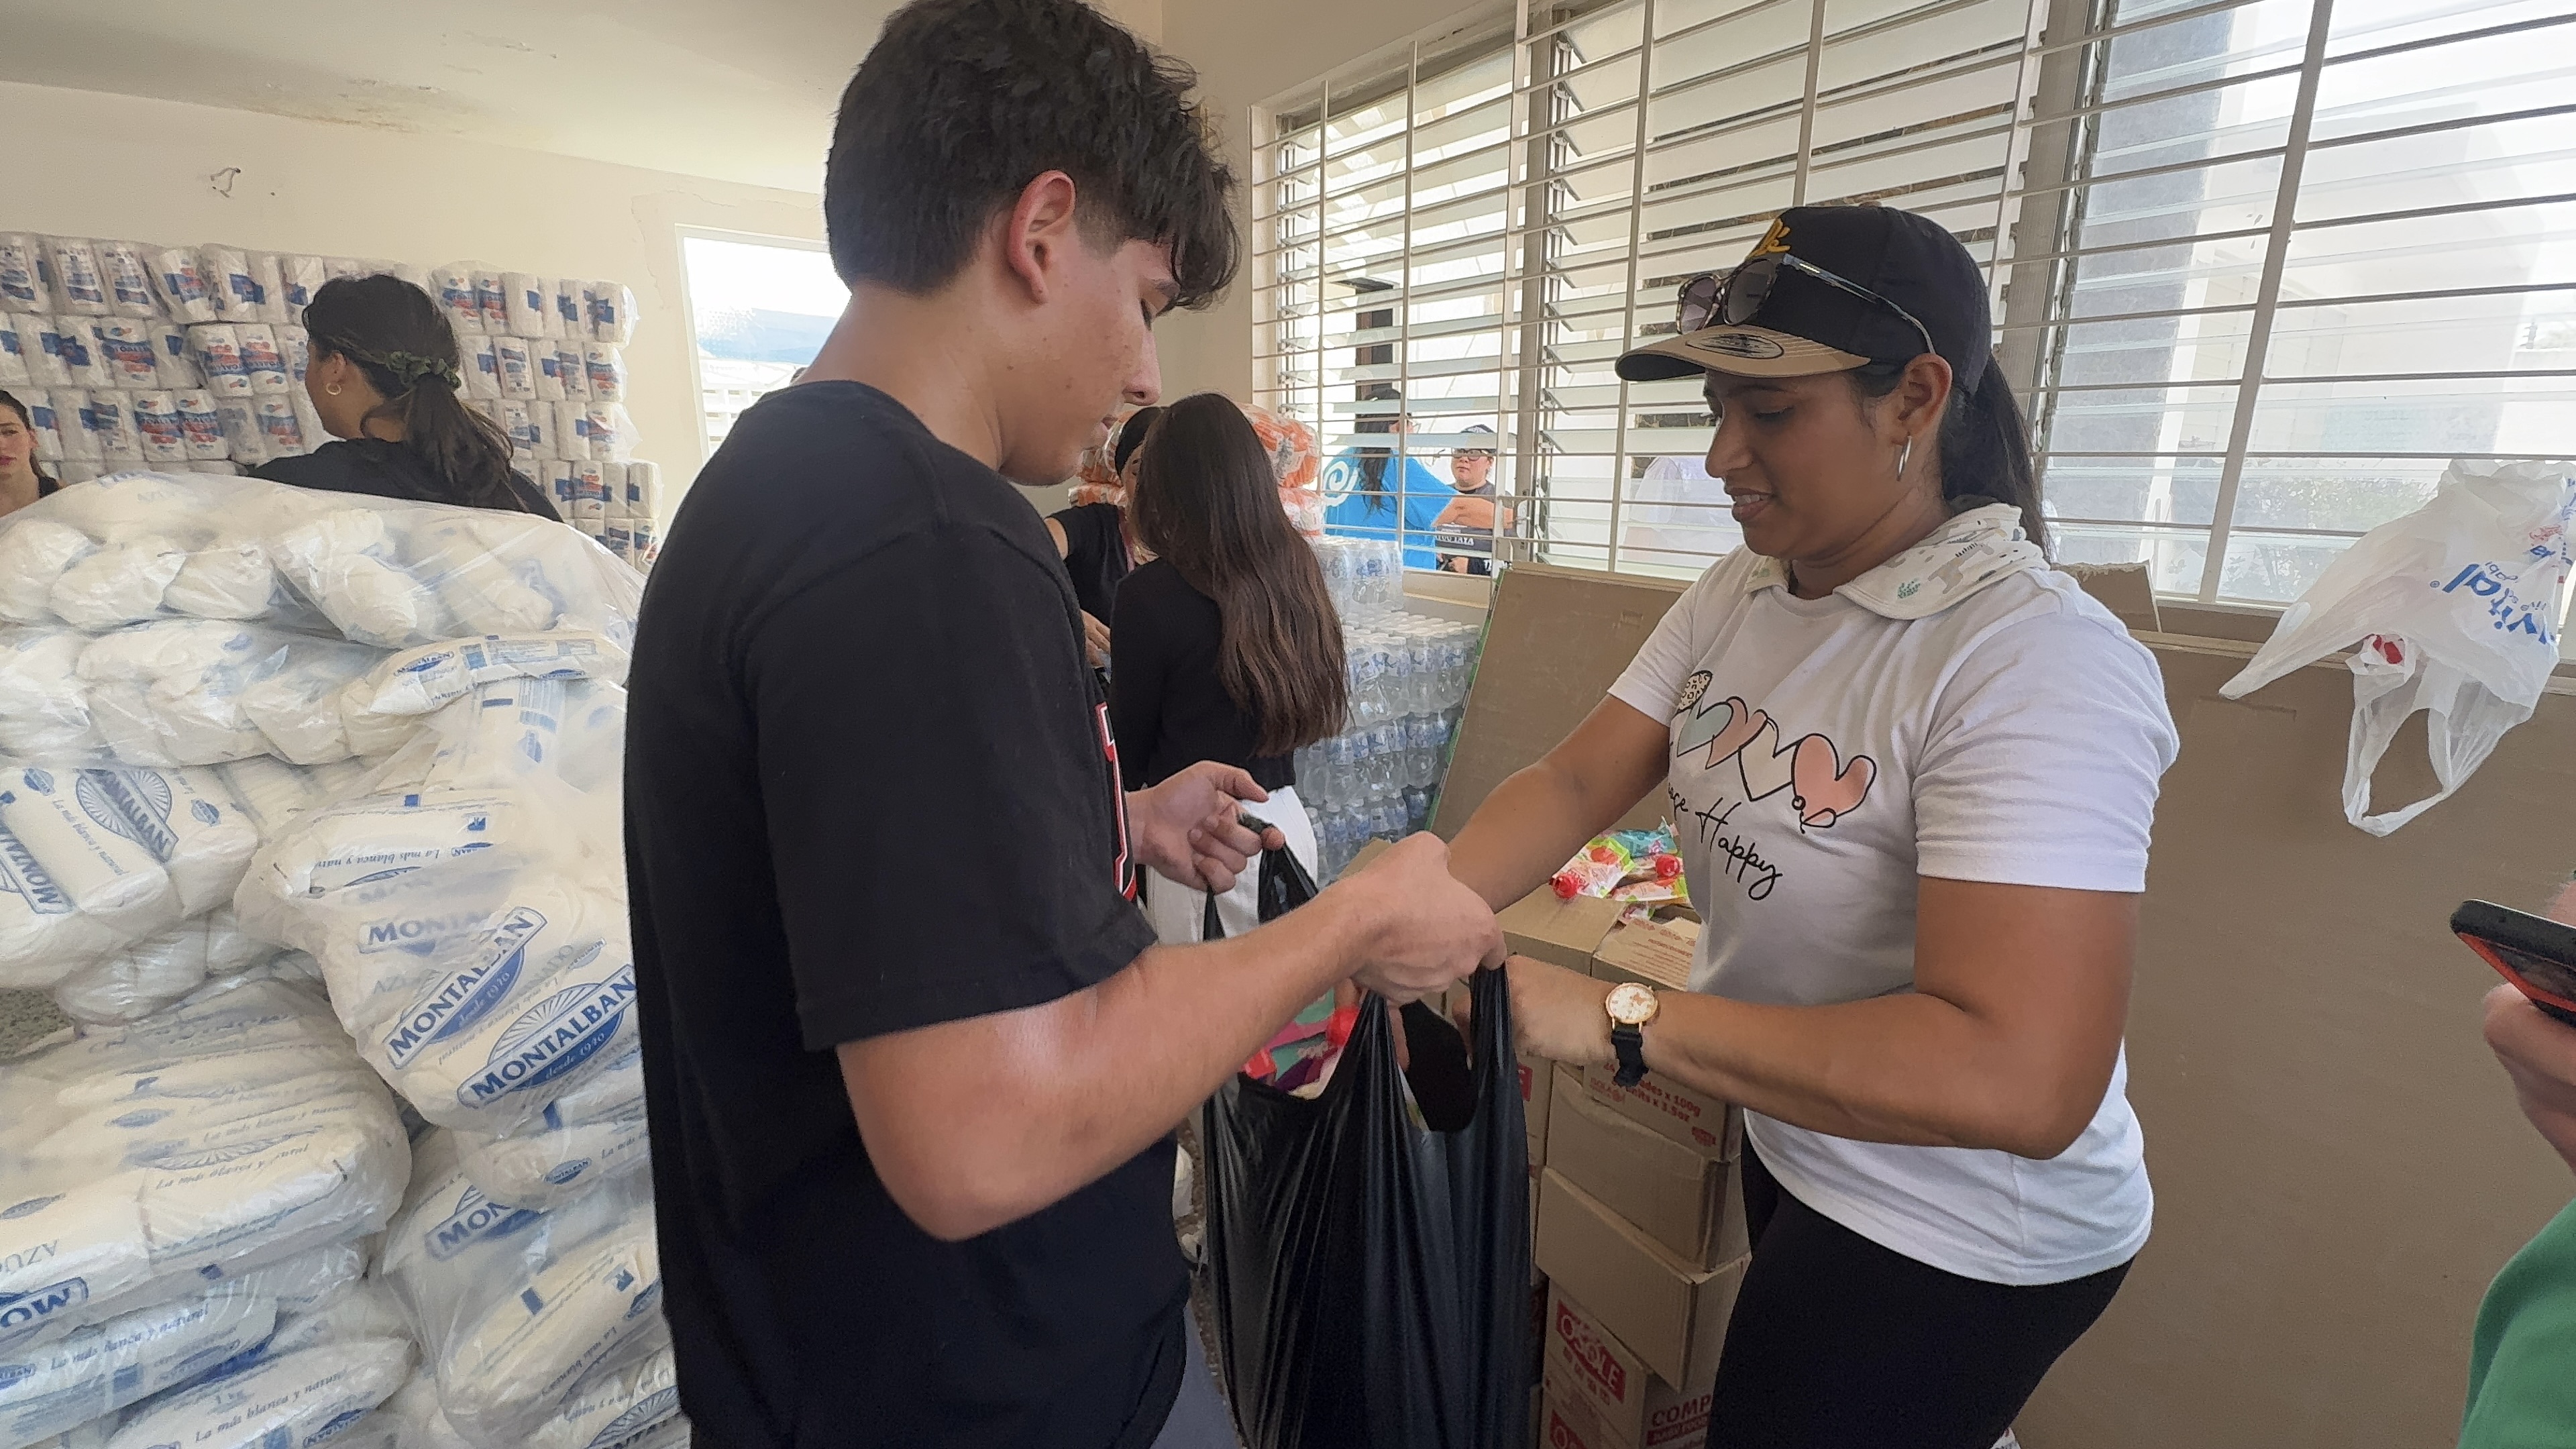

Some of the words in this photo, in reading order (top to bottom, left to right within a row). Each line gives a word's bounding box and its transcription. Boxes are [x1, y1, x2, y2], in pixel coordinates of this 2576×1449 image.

[1695, 797, 1784, 901] Happy
[470, 974, 636, 1101] MONTALBAN
[1652, 1395, 1711, 1428] COMP
